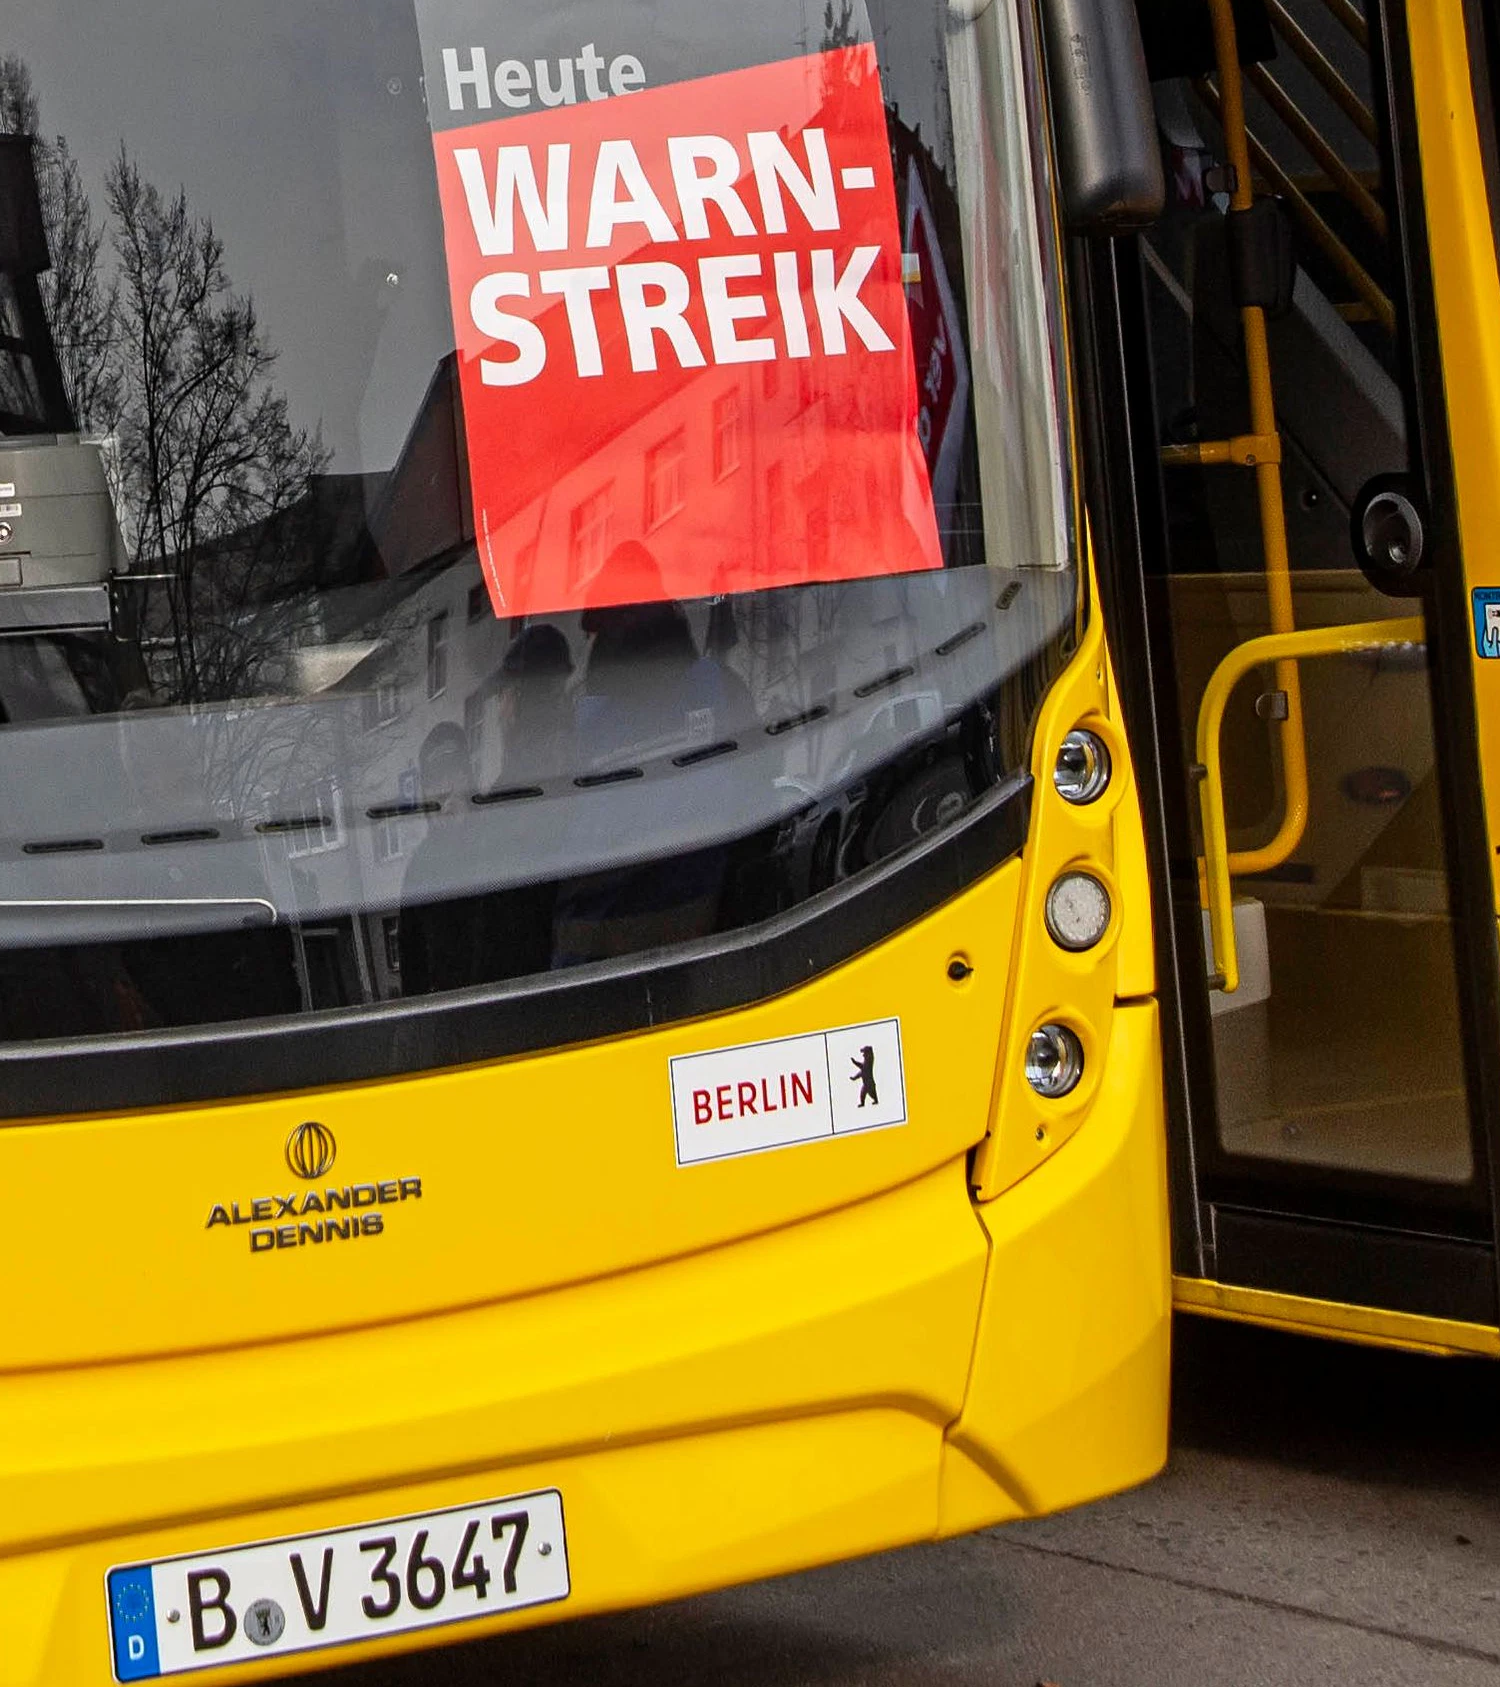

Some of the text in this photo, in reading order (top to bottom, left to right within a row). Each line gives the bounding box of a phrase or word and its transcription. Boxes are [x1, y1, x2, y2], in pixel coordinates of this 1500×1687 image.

[442, 42, 646, 111] Heute
[452, 127, 875, 257] WARN-
[467, 245, 896, 387] STREIK
[693, 1070, 815, 1126] BERLIN
[206, 1176, 423, 1234] ALEXANDER
[250, 1212, 385, 1253] DENNIS
[187, 1568, 238, 1653] B
[289, 1549, 334, 1631] V
[359, 1512, 531, 1620] 3647
